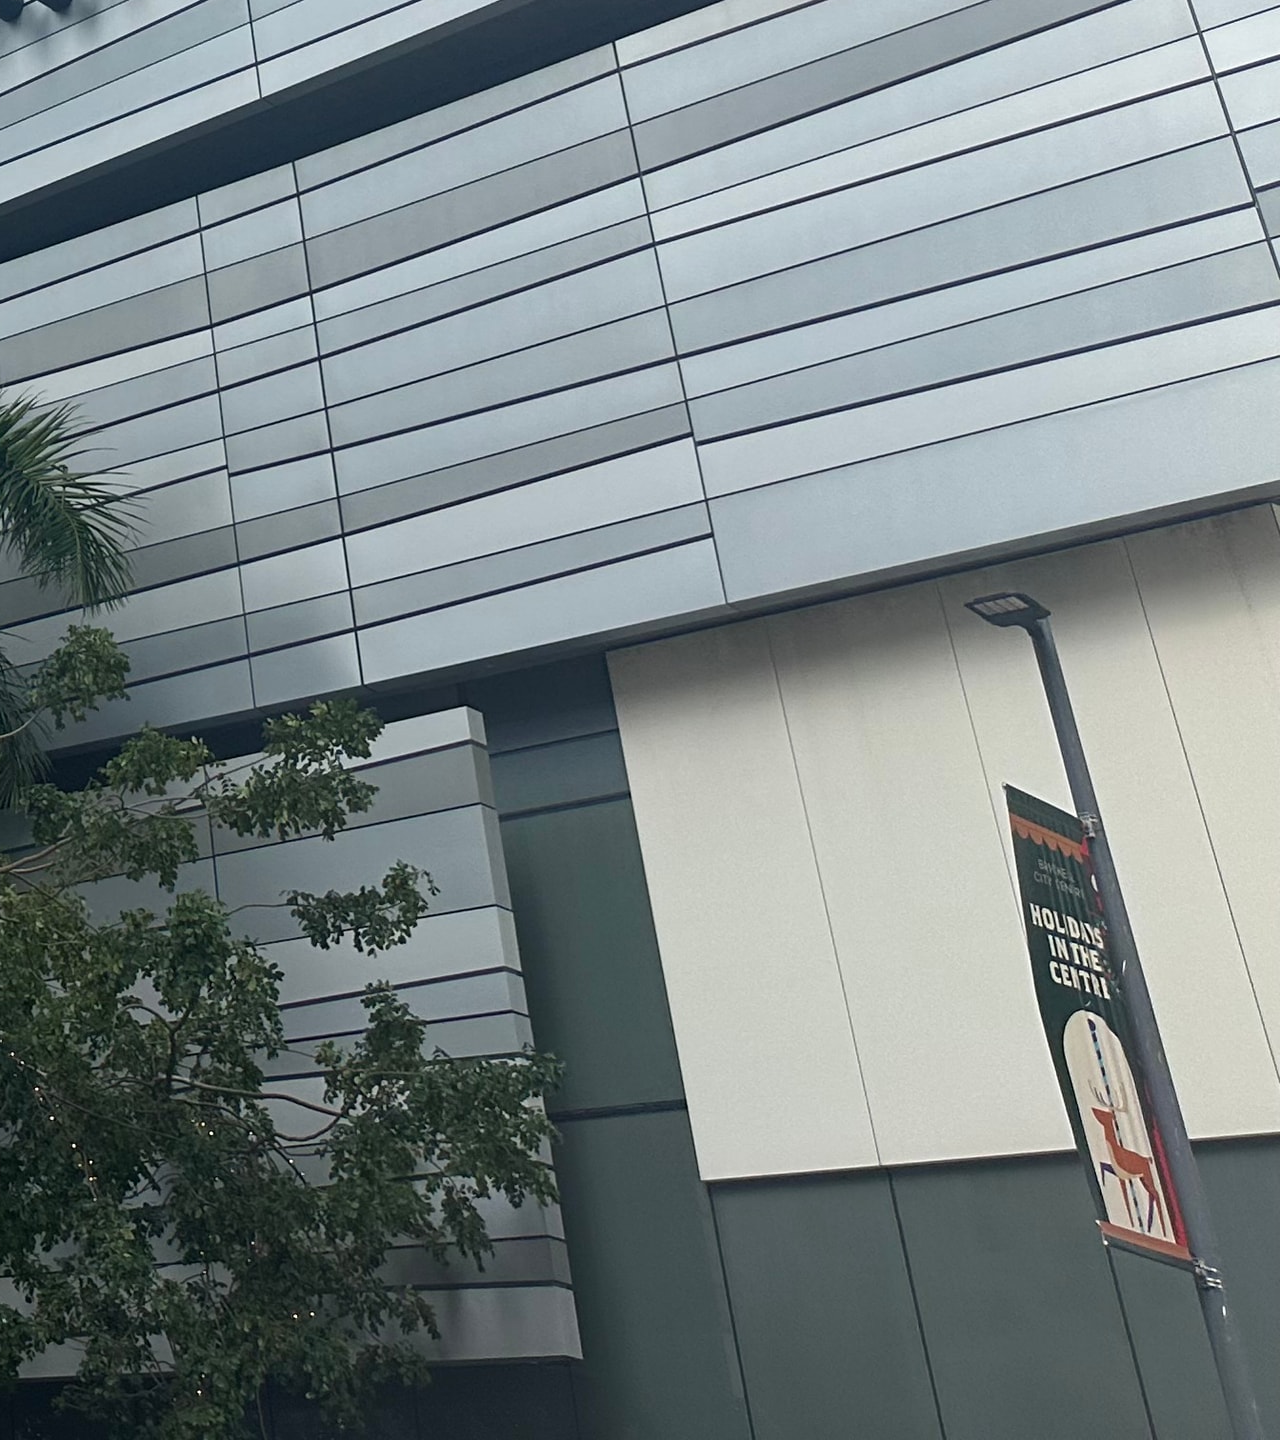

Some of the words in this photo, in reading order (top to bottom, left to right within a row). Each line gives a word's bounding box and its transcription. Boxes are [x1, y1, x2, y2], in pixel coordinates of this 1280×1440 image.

[1029, 902, 1105, 949] HOLIDAYS
[1047, 933, 1070, 961] IN
[1069, 941, 1103, 972] THE
